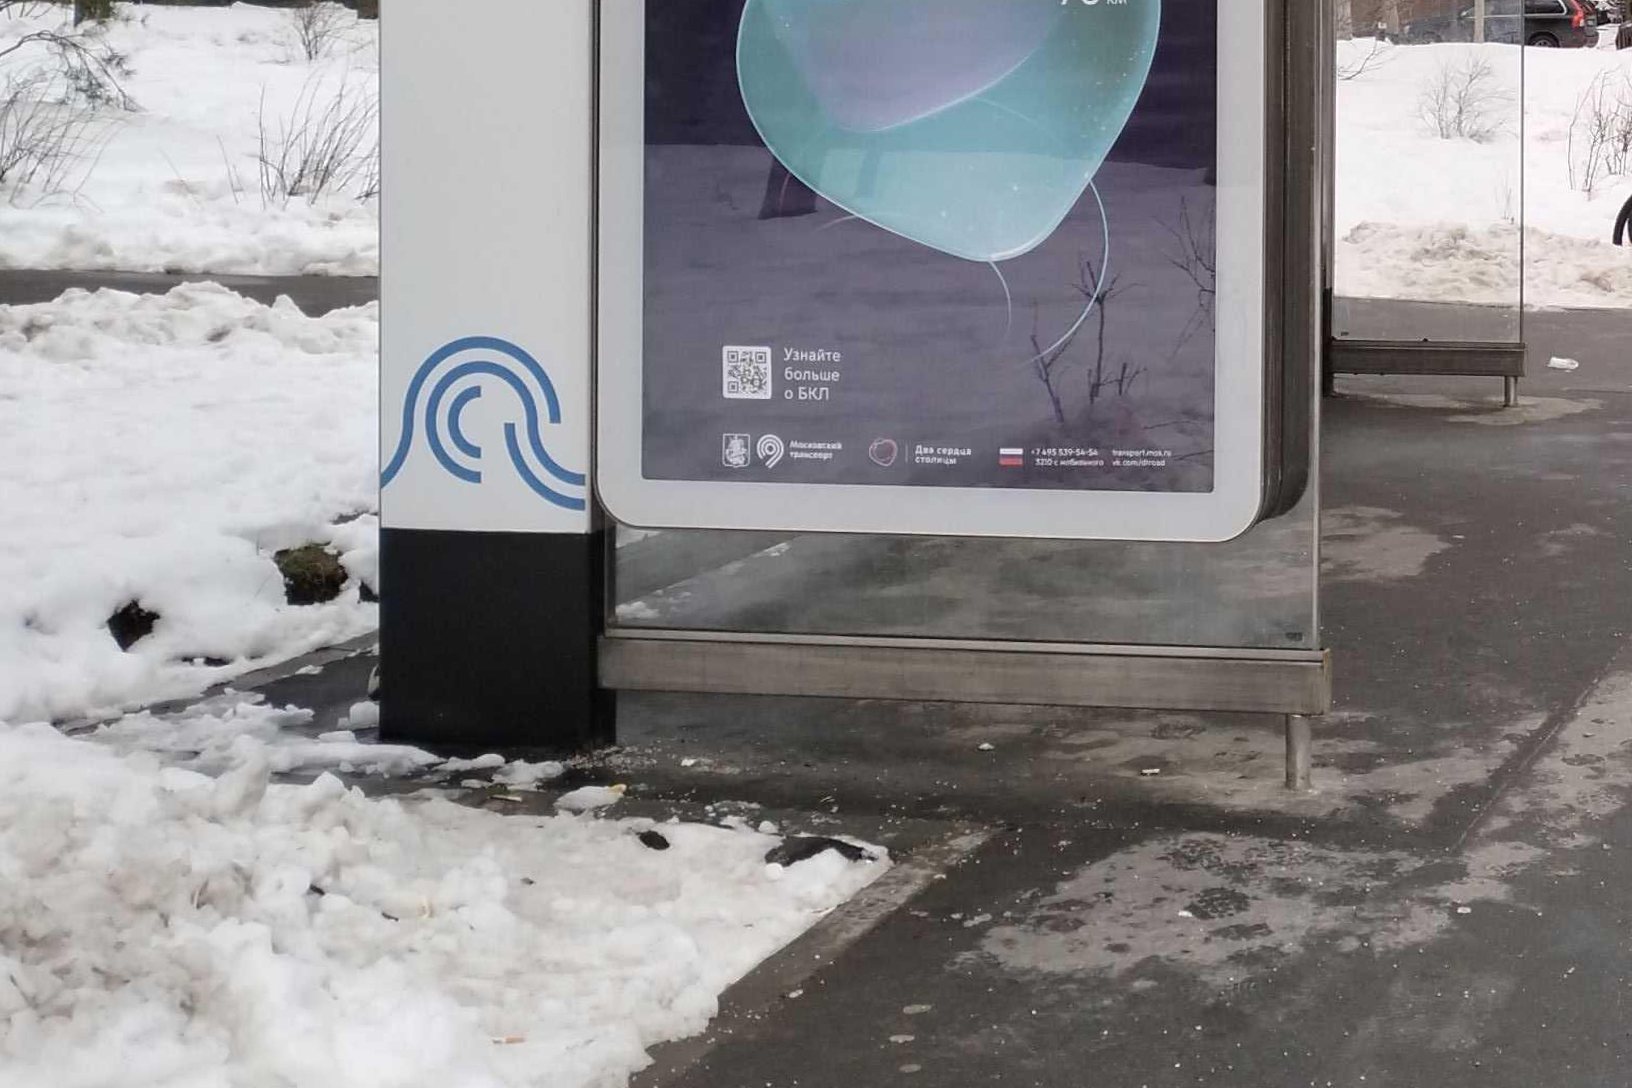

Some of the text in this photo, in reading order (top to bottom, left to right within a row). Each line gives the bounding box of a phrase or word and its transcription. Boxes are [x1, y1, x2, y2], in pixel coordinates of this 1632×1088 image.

[783, 346, 842, 363] Узнайте
[784, 366, 841, 382] больше
[784, 387, 830, 400] о БКЛ
[914, 444, 935, 456] Два
